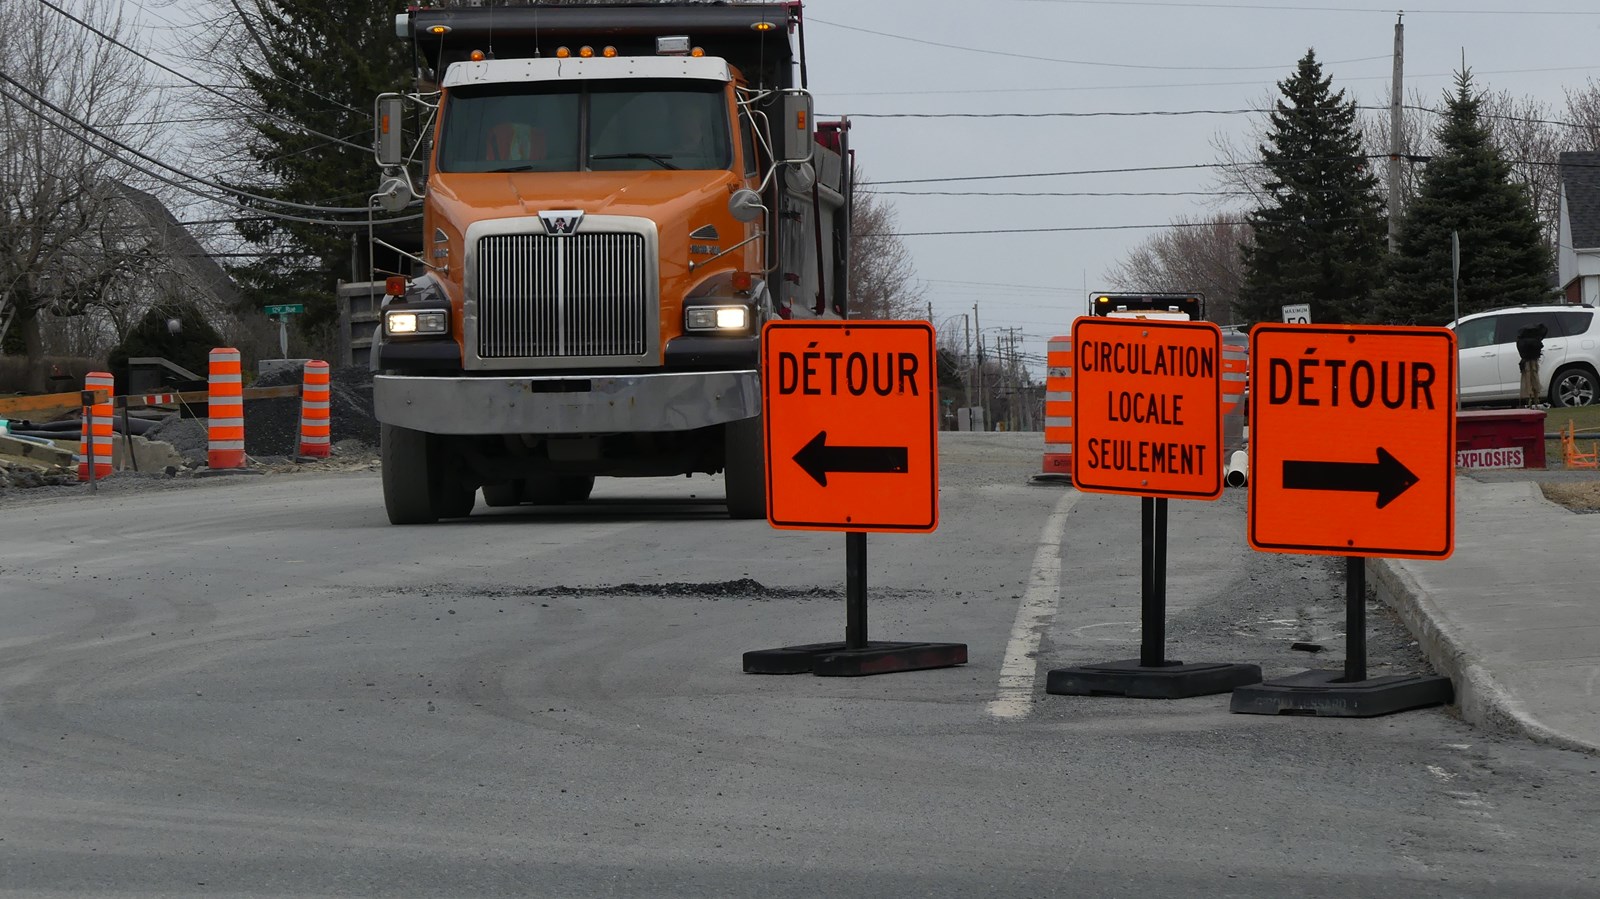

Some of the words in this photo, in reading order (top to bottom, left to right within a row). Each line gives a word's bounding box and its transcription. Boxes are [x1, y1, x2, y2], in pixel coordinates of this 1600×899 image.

[779, 341, 919, 397] DÉTOUR
[1081, 340, 1214, 379] CIRCULATION
[1269, 347, 1436, 410] DÉTOUR
[1108, 391, 1184, 426] LOCALE
[1088, 437, 1206, 476] SEULEMENT
